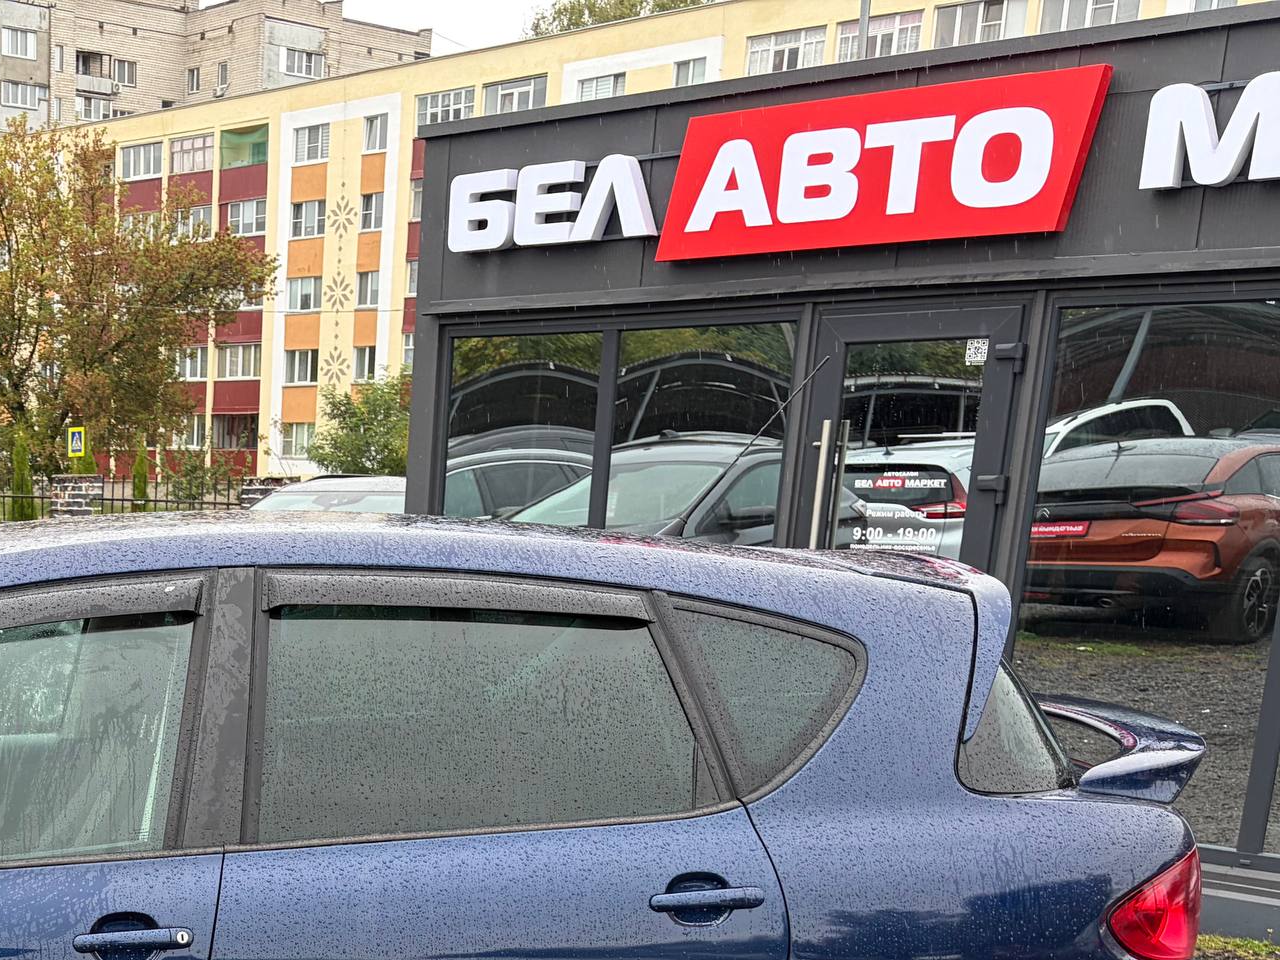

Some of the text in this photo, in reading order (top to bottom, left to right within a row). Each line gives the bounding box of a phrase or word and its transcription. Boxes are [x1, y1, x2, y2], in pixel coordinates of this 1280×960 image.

[447, 153, 658, 252] БЕЛ
[684, 106, 1055, 233] АВТО
[854, 479, 947, 488] БЕЛ АВТО МАРКЕТ
[866, 509, 927, 519] Режим работы
[852, 527, 883, 540] 9:00
[897, 527, 936, 540] 19:00
